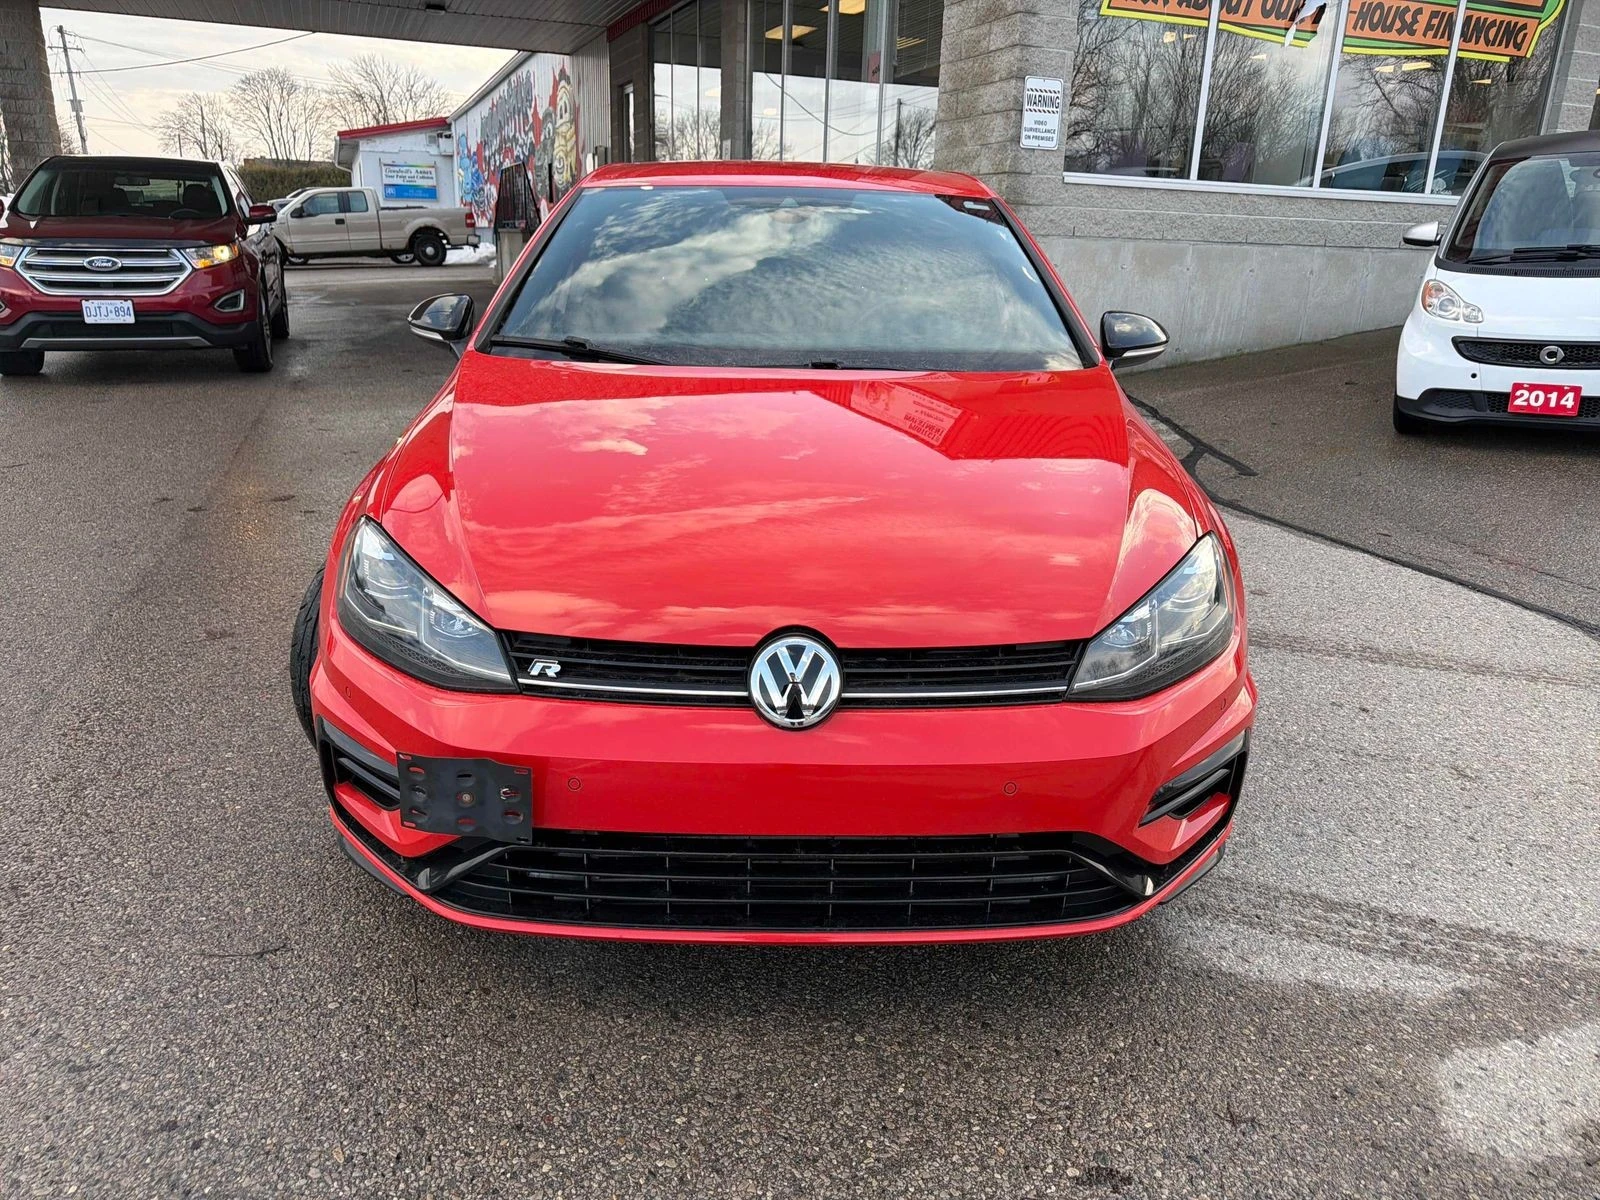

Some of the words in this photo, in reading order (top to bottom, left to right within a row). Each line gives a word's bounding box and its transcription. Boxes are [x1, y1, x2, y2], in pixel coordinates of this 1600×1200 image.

[1422, 10, 1528, 52] FINANCING
[1026, 93, 1060, 109] WARNING
[1024, 127, 1056, 135] SURVEILLANCE
[1513, 389, 1575, 409] 2014
[526, 658, 562, 679] R
